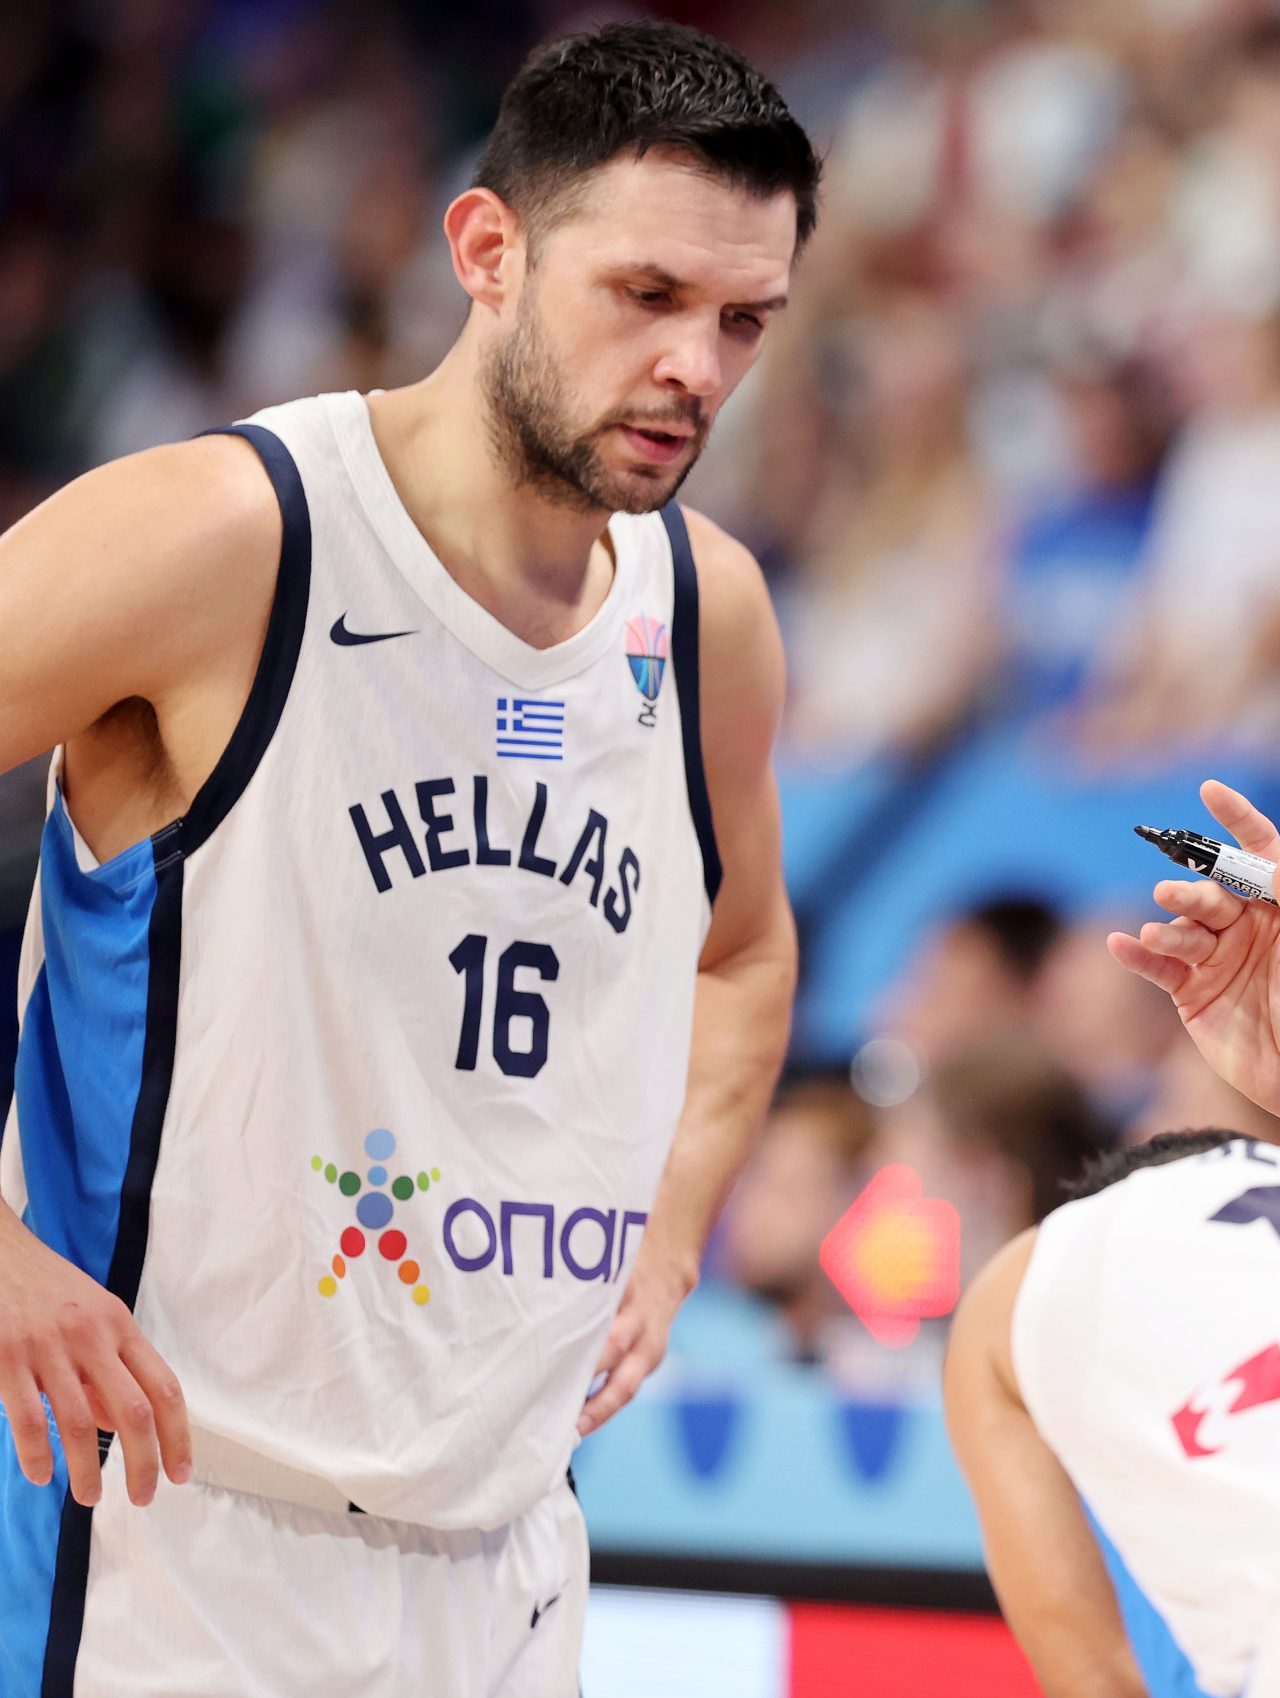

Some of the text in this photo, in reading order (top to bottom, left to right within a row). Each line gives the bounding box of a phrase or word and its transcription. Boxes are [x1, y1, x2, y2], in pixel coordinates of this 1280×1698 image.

[349, 776, 640, 933] HELLAS
[1211, 873, 1261, 898] BOARD
[449, 934, 560, 1078] 16
